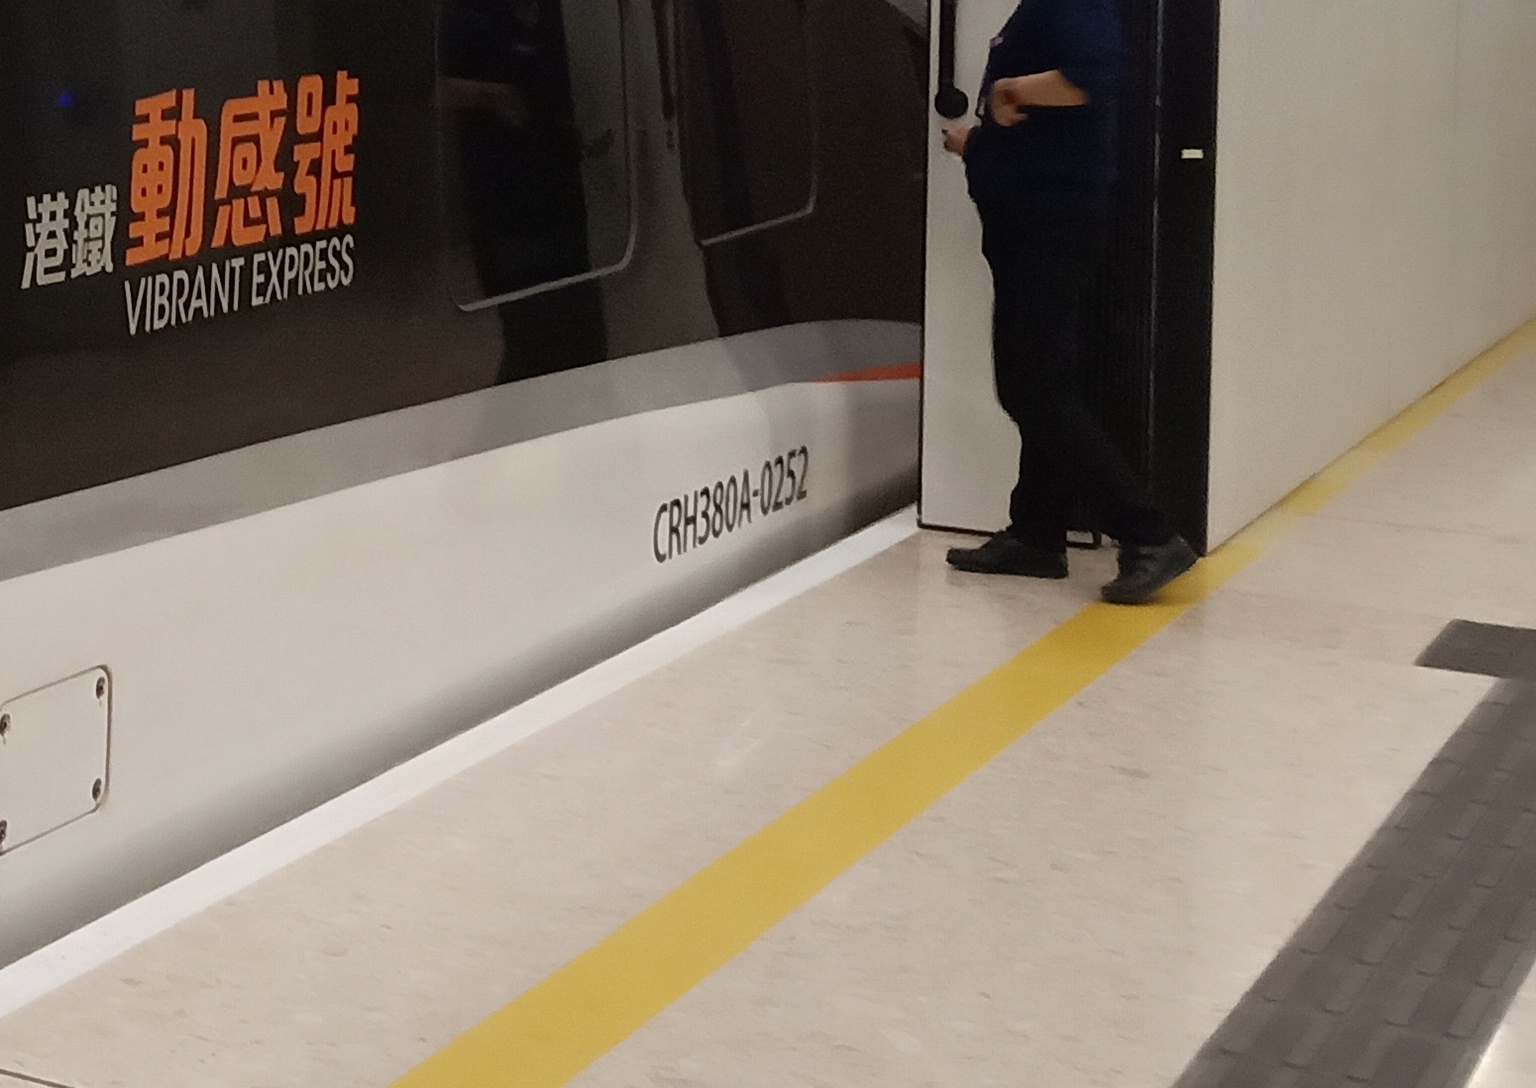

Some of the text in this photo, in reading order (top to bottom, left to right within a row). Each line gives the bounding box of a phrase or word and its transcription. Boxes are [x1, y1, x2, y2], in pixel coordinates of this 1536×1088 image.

[21, 69, 360, 289] 港鐵 動感號
[124, 233, 356, 336] VIBRANT EXPRESS
[653, 444, 810, 564] CRH380A-0252
